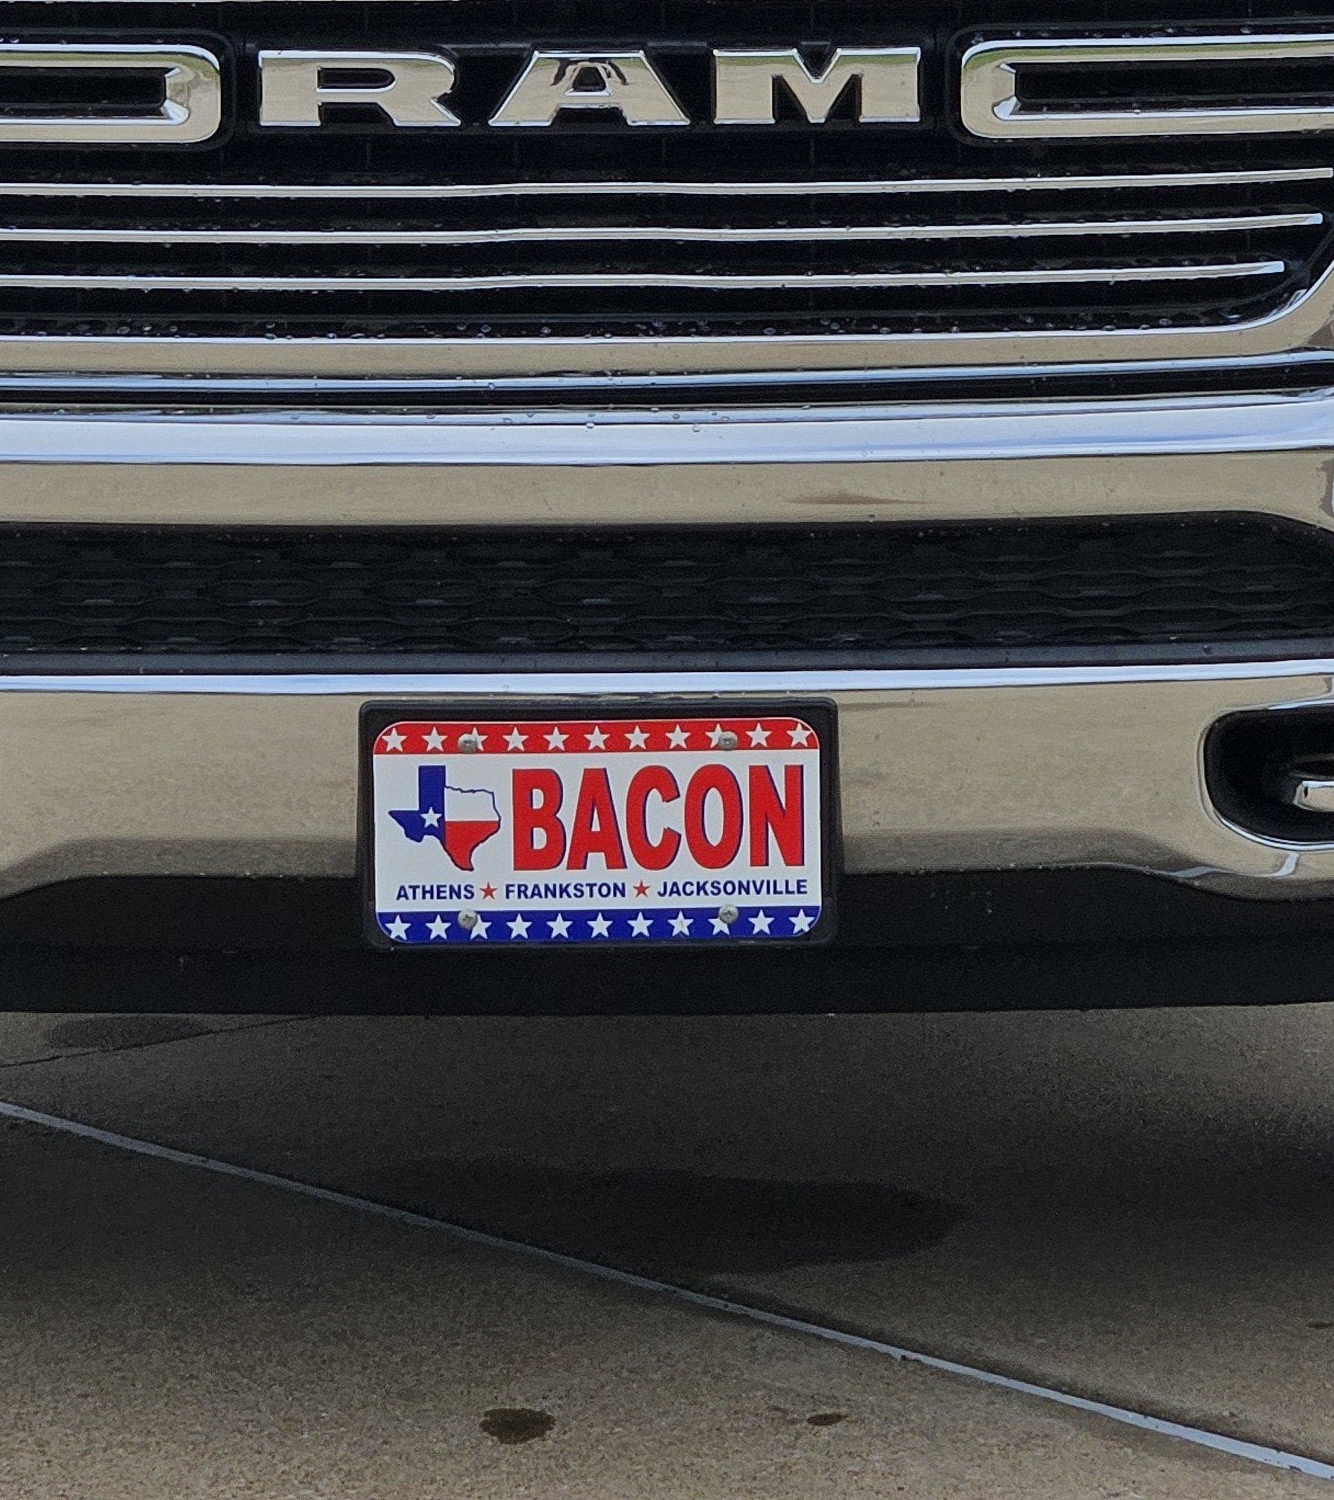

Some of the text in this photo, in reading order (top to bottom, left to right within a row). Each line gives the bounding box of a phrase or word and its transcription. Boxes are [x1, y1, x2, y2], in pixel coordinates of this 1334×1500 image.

[259, 47, 921, 127] RAM
[512, 763, 805, 871] BACON
[396, 878, 808, 901] ATHENS FRANKSTON JACKSONVILLE
